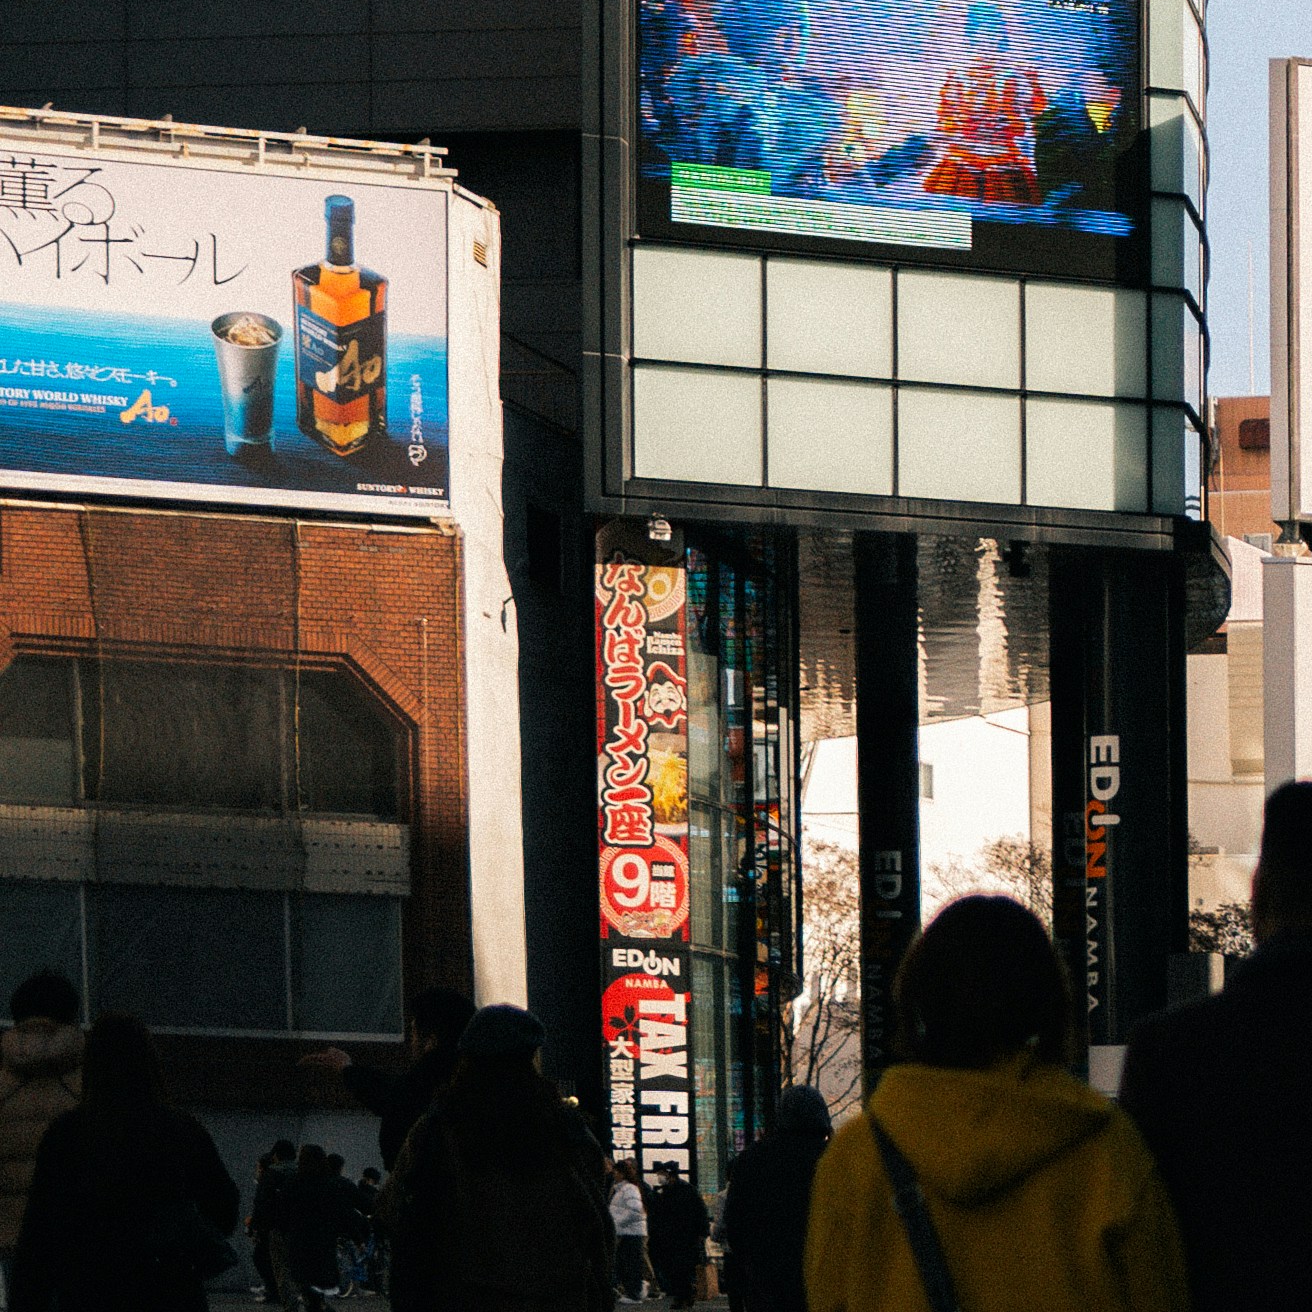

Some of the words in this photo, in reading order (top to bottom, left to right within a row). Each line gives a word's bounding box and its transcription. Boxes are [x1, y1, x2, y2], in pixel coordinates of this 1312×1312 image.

[33, 390, 78, 403] WORLD
[81, 393, 128, 407] WHISKY
[606, 553, 650, 843] なんばラーメン一座
[1086, 734, 1121, 880] EDION
[611, 852, 650, 908] 9
[651, 881, 677, 909] 階
[611, 948, 681, 977] EDION
[1086, 886, 1100, 1014] NAMBA
[625, 978, 668, 988] NAMBA
[639, 993, 689, 1081] TAX
